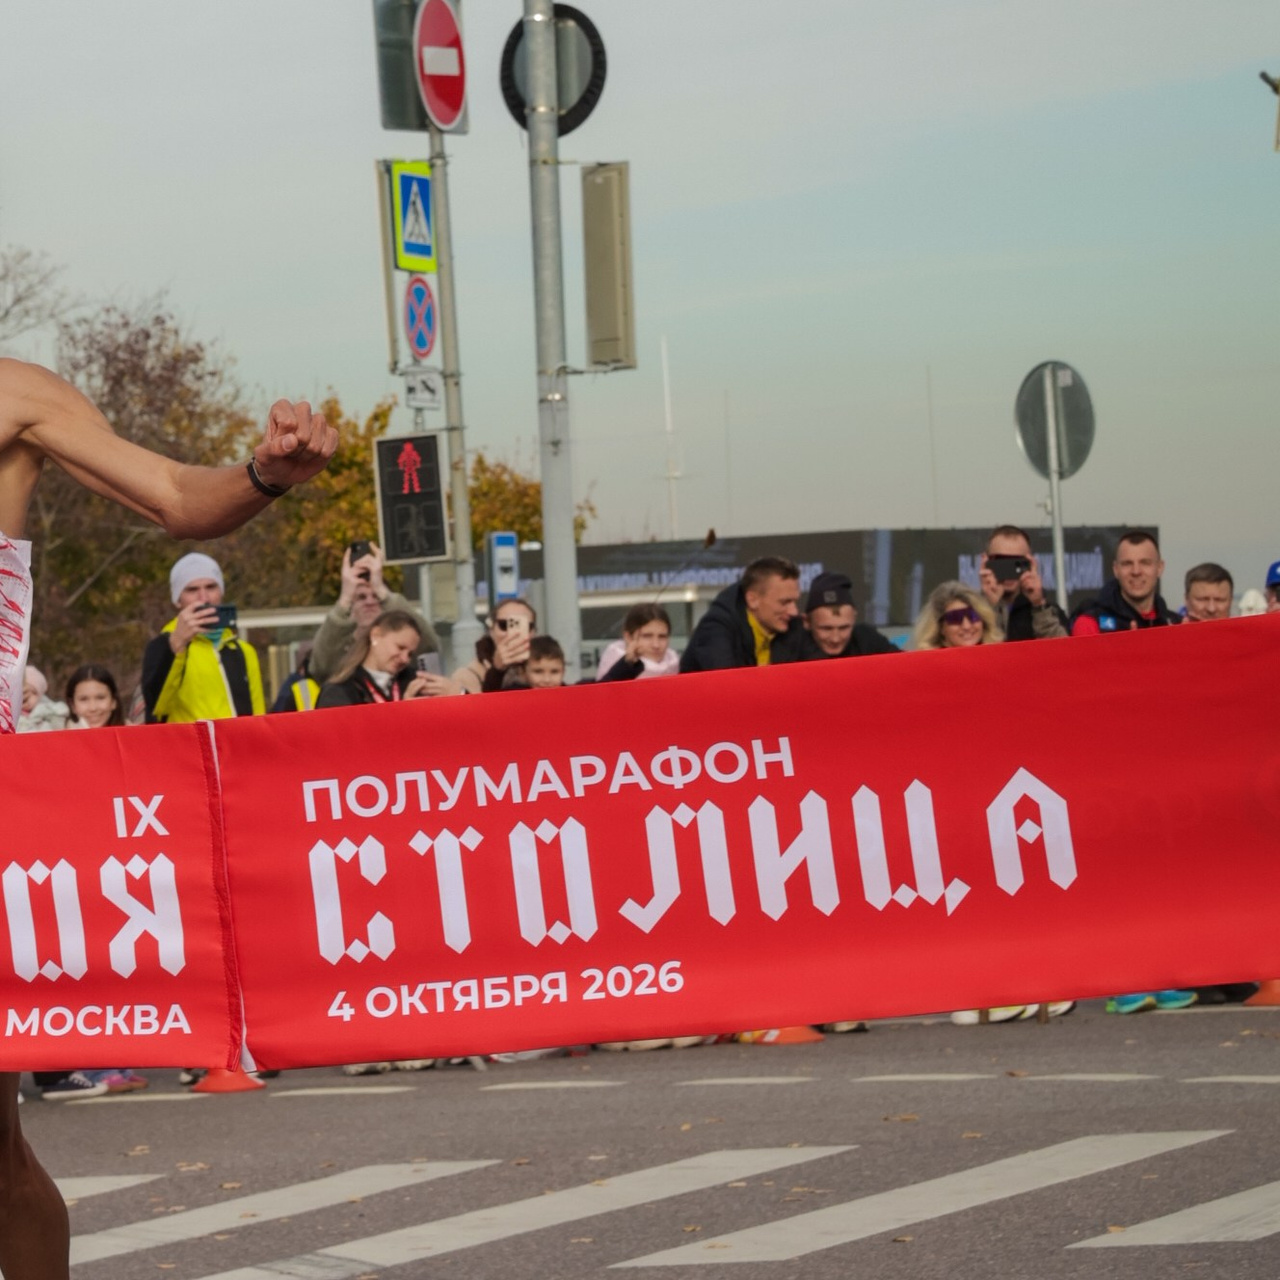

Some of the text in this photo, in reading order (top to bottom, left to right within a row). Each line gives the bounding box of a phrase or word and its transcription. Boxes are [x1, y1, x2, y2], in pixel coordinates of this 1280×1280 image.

[112, 736, 795, 839] IX ПОЛУМАРАФОН
[308, 766, 1078, 966] СТОЛИЦА
[4, 1003, 192, 1037] МОСКВА
[327, 960, 685, 1022] 4 ОКТЯБРЯ 2026
